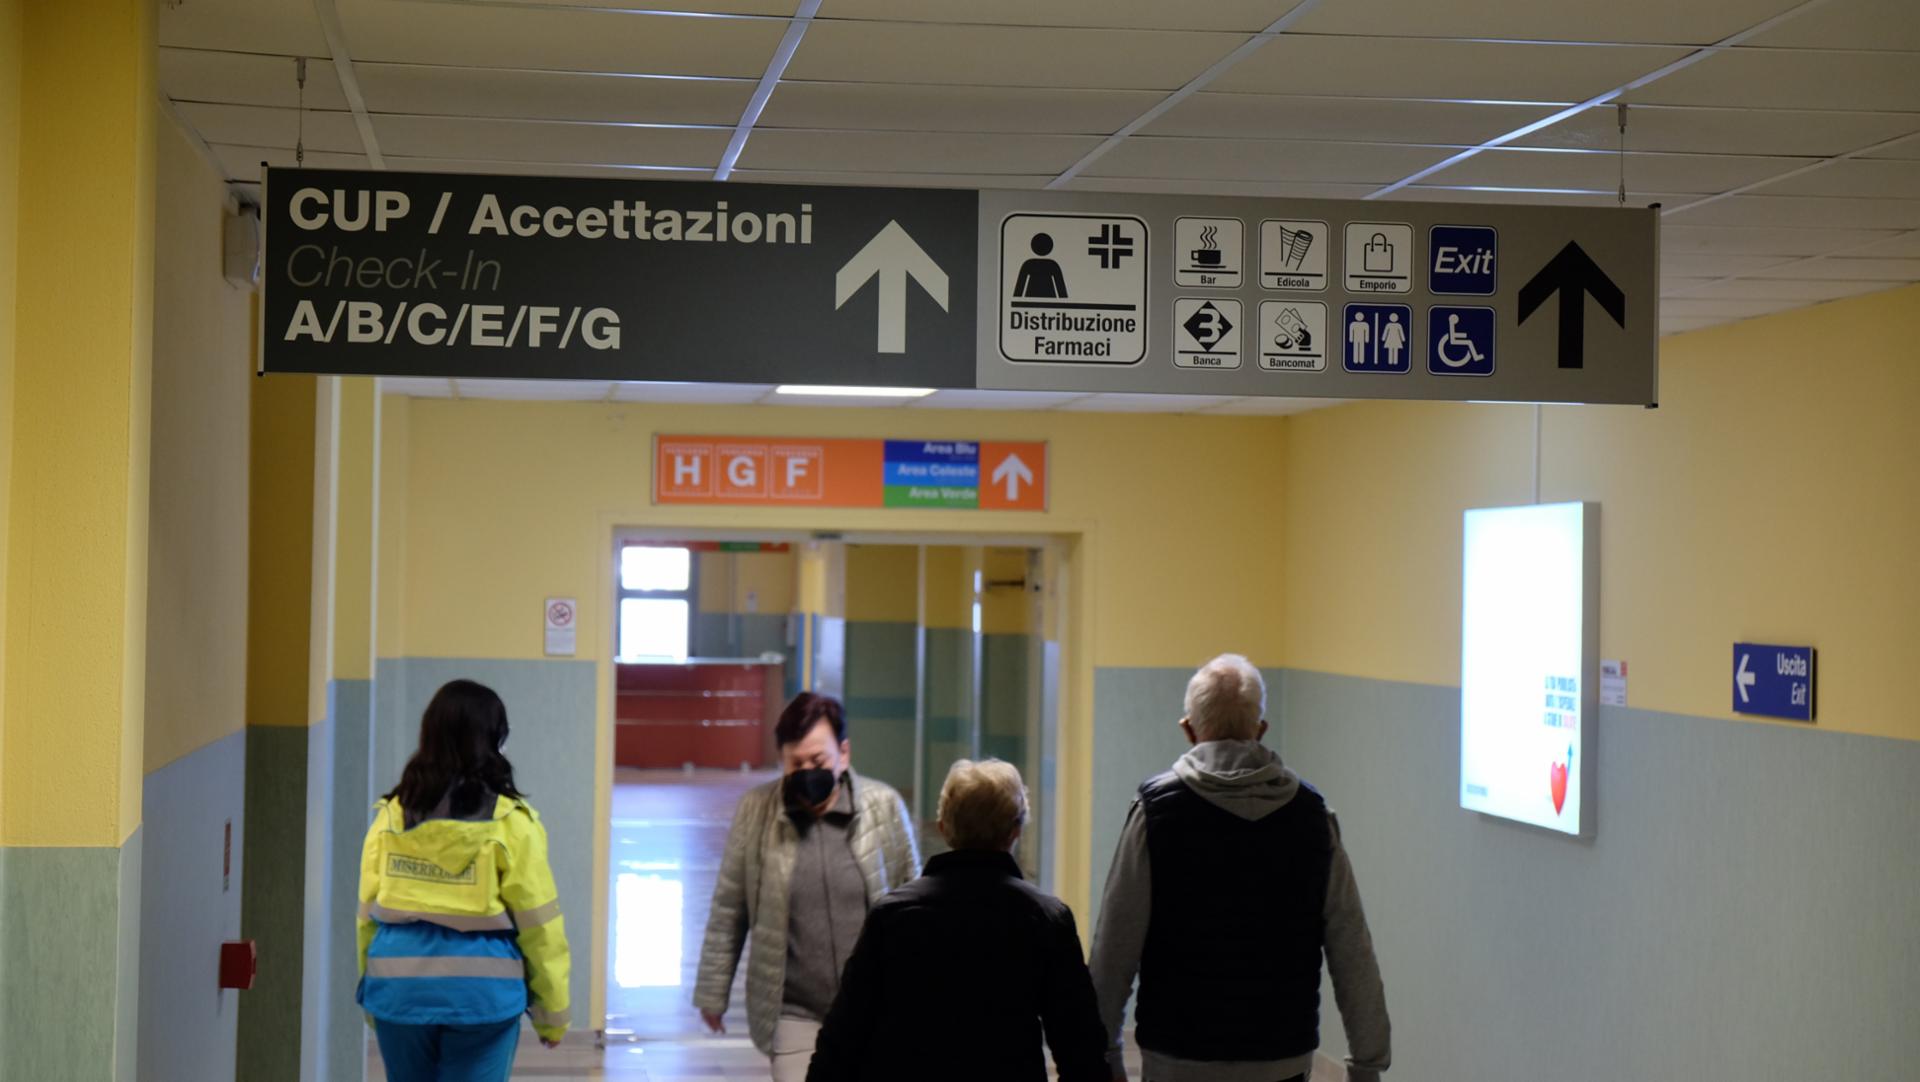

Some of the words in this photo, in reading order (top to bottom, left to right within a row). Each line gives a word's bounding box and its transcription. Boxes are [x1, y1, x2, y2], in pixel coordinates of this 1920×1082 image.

[289, 187, 411, 232] CUP
[428, 191, 453, 234] /
[468, 193, 813, 246] Accettazioni
[286, 244, 502, 292] Check-In
[1434, 246, 1494, 275] Exit
[1200, 274, 1216, 285] Bar
[1276, 276, 1310, 288] Edicola
[1359, 279, 1396, 291] Emporio
[284, 300, 622, 351] A/B/C/E/F/G
[1010, 311, 1136, 333] Distribuzione
[1034, 336, 1111, 357] Farmaci
[1192, 355, 1222, 366] Banca
[1269, 357, 1315, 369] Bancomat
[923, 443, 953, 454] Area
[674, 455, 701, 486] H
[727, 455, 756, 487] G
[786, 457, 809, 488] F
[897, 464, 928, 476] Area
[929, 464, 976, 477] Celeste
[909, 487, 939, 499] Area
[941, 488, 977, 499] Verde
[1776, 652, 1807, 677] Uscita
[1791, 682, 1807, 705] Exit
